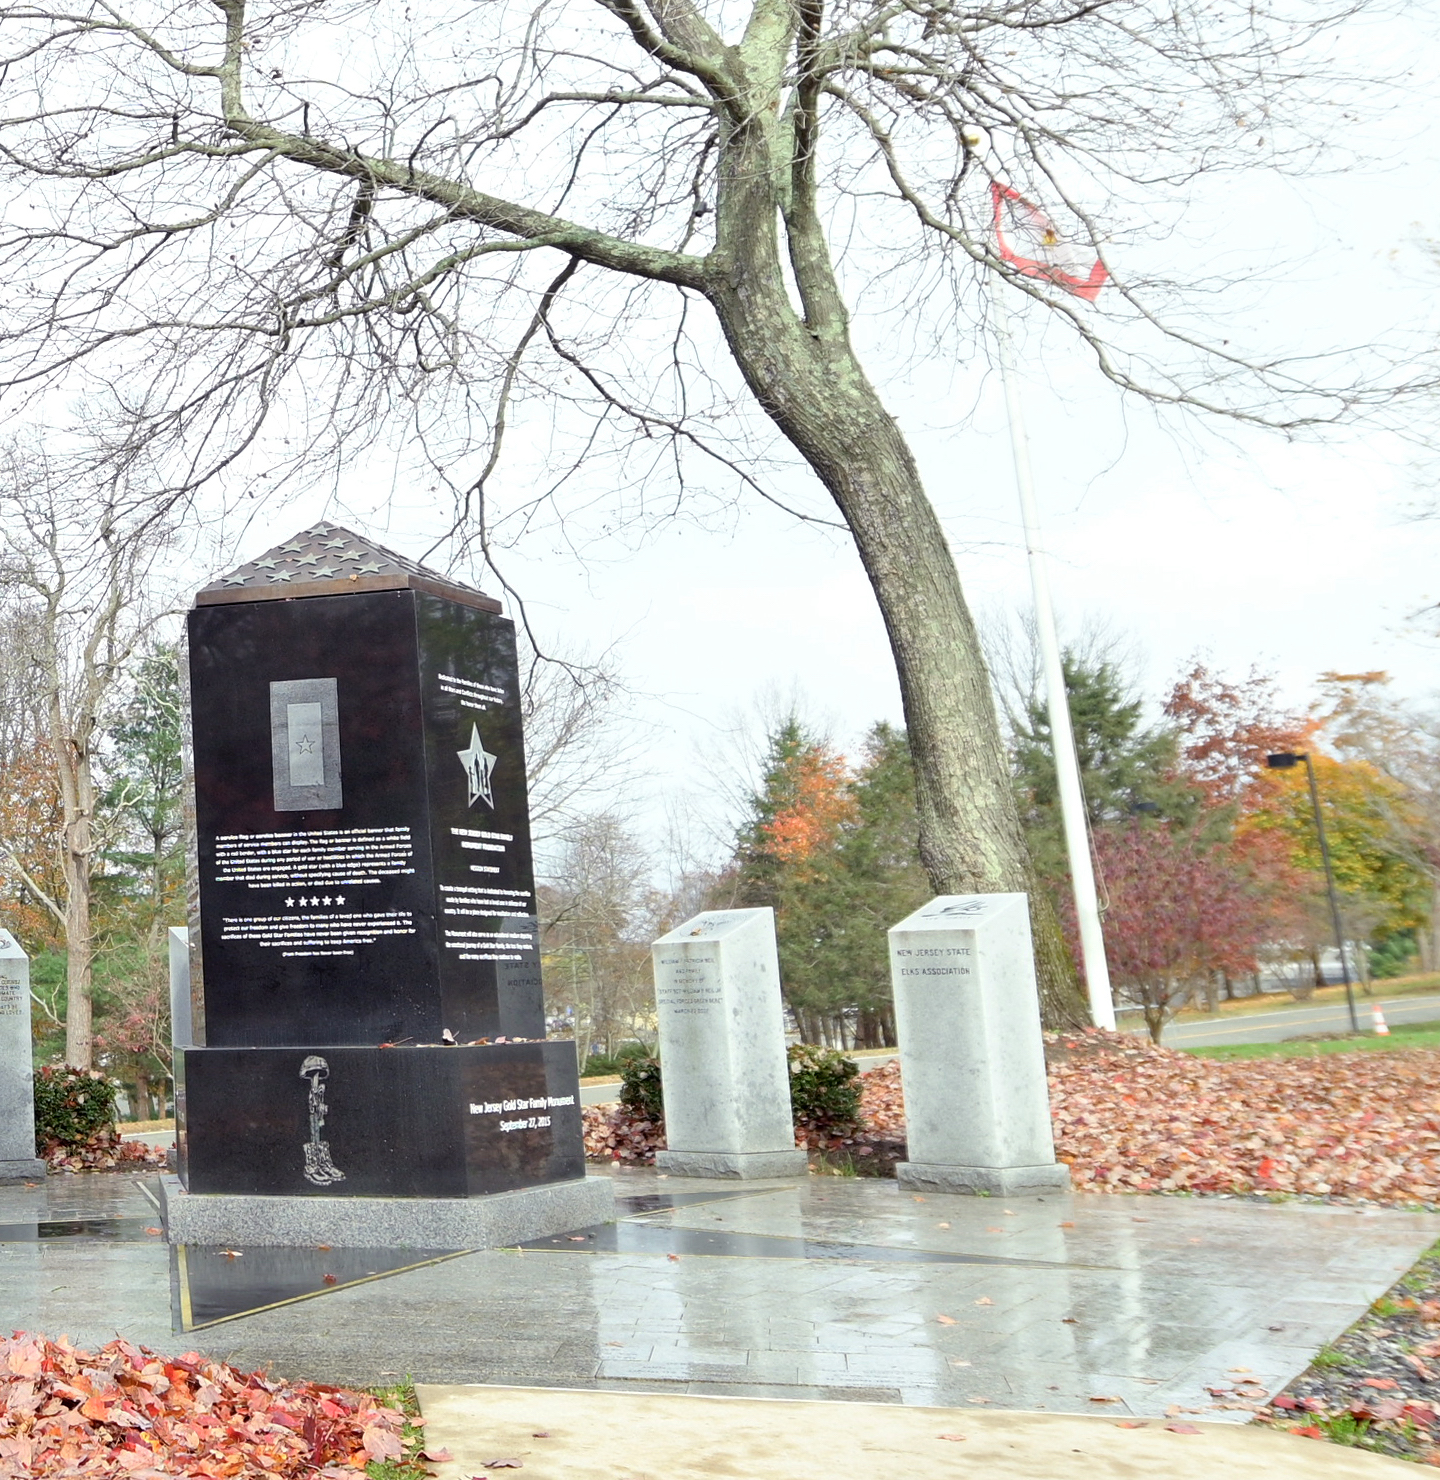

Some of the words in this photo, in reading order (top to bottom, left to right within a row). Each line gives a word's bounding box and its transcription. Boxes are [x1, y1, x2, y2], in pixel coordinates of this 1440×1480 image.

[897, 949, 912, 957] NEW
[915, 948, 944, 957] JERSEY
[946, 948, 970, 956] STATE
[902, 967, 919, 976] ELKS
[922, 967, 970, 975] ASSOCIATION
[470, 1103, 483, 1114] New
[484, 1102, 502, 1113] Jersey
[503, 1099, 516, 1111] Gold
[517, 1099, 529, 1110] Star
[529, 1097, 547, 1109] Family
[547, 1095, 575, 1107] Monument
[500, 1119, 528, 1133] September
[537, 1116, 551, 1127] 2015
